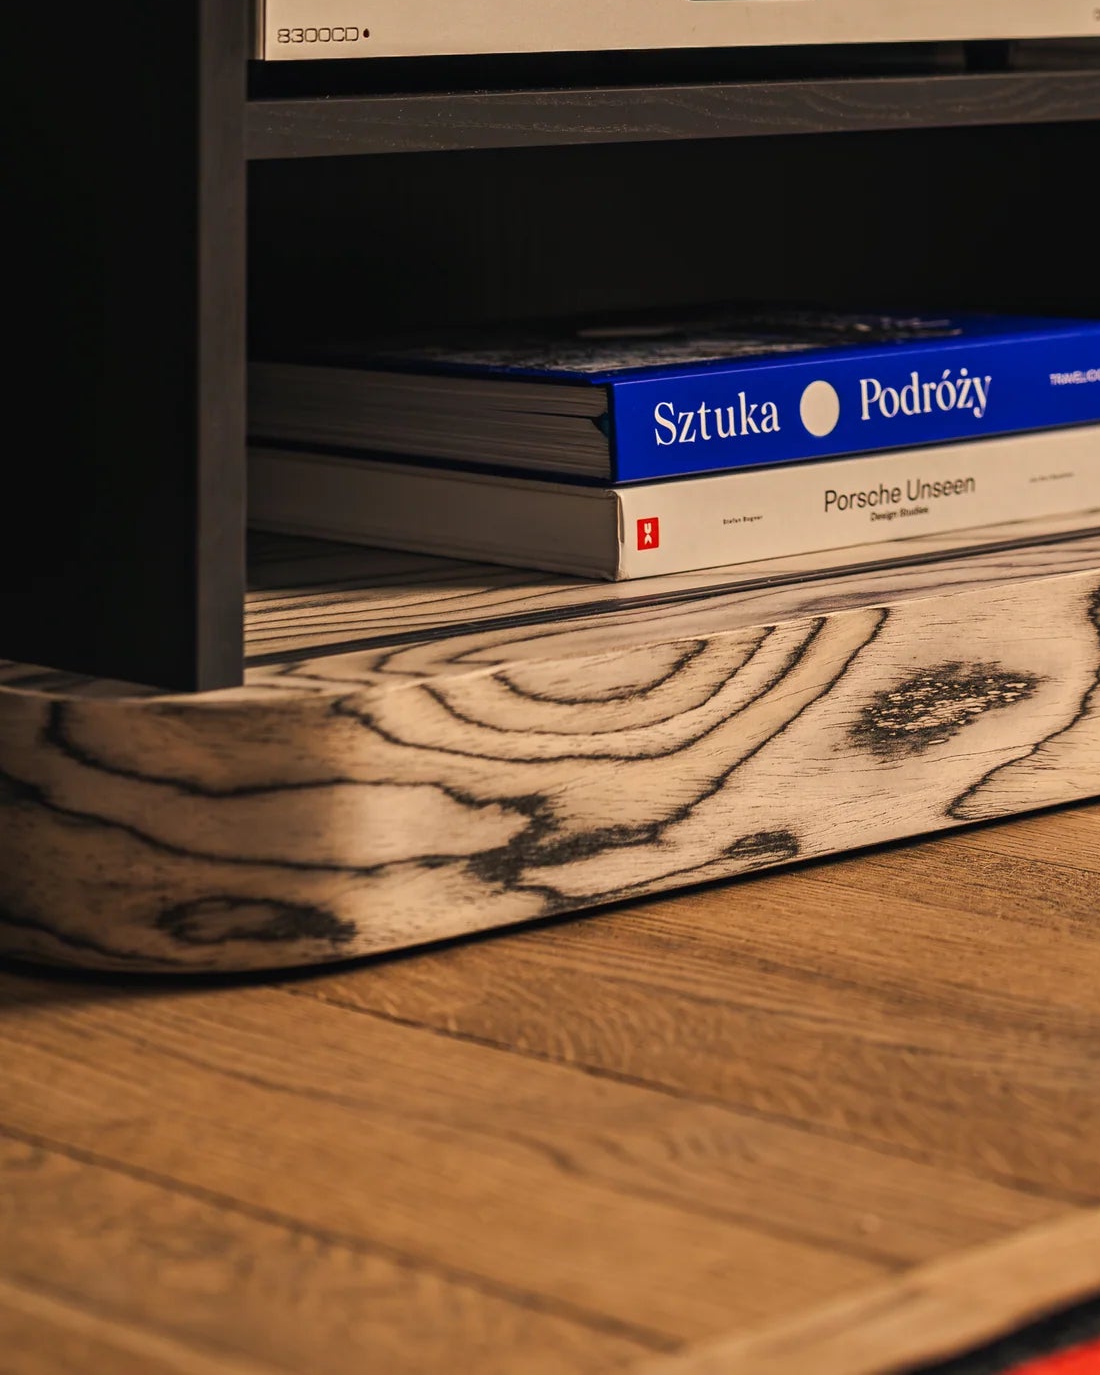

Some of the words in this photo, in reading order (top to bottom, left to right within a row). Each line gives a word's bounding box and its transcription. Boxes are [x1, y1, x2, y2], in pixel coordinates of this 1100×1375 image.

[277, 27, 359, 44] 8300CD
[653, 392, 781, 447] Sztuka
[859, 367, 992, 420] Podróży
[824, 483, 902, 513] Porsche
[907, 476, 976, 501] Unseen
[870, 511, 897, 522] Design
